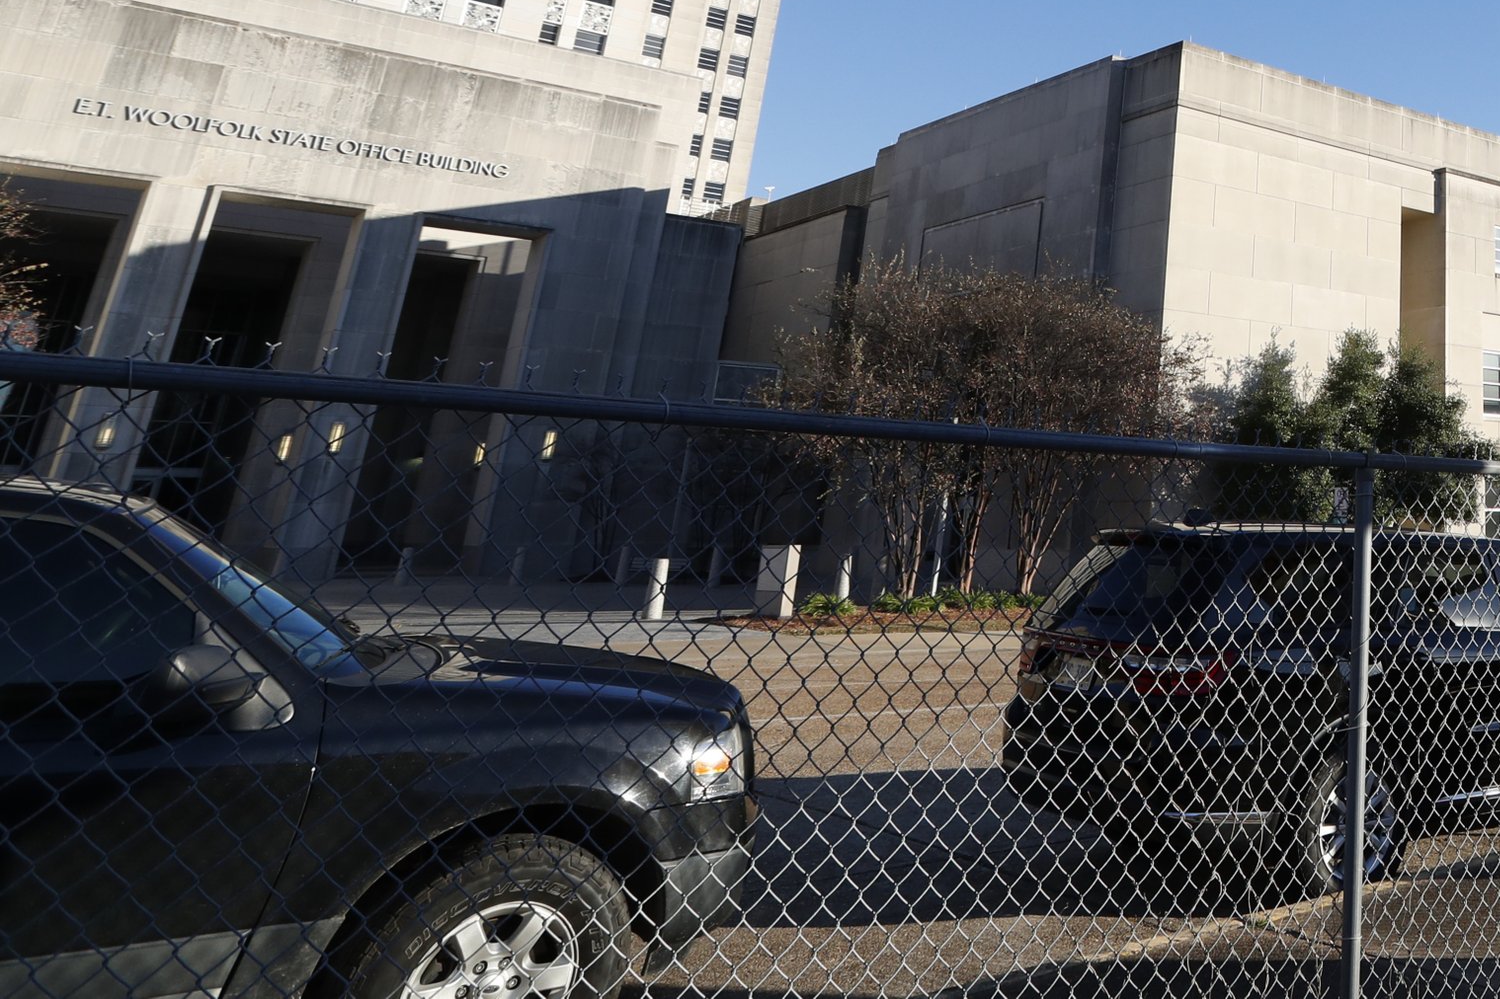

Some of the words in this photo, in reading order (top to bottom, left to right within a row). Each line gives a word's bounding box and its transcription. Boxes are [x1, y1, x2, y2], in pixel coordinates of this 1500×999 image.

[72, 97, 115, 119] E.T.
[124, 105, 265, 142] WOOLFOLK
[267, 128, 334, 152] STATE
[335, 139, 416, 165] OFFICE
[415, 151, 510, 179] BUILDING
